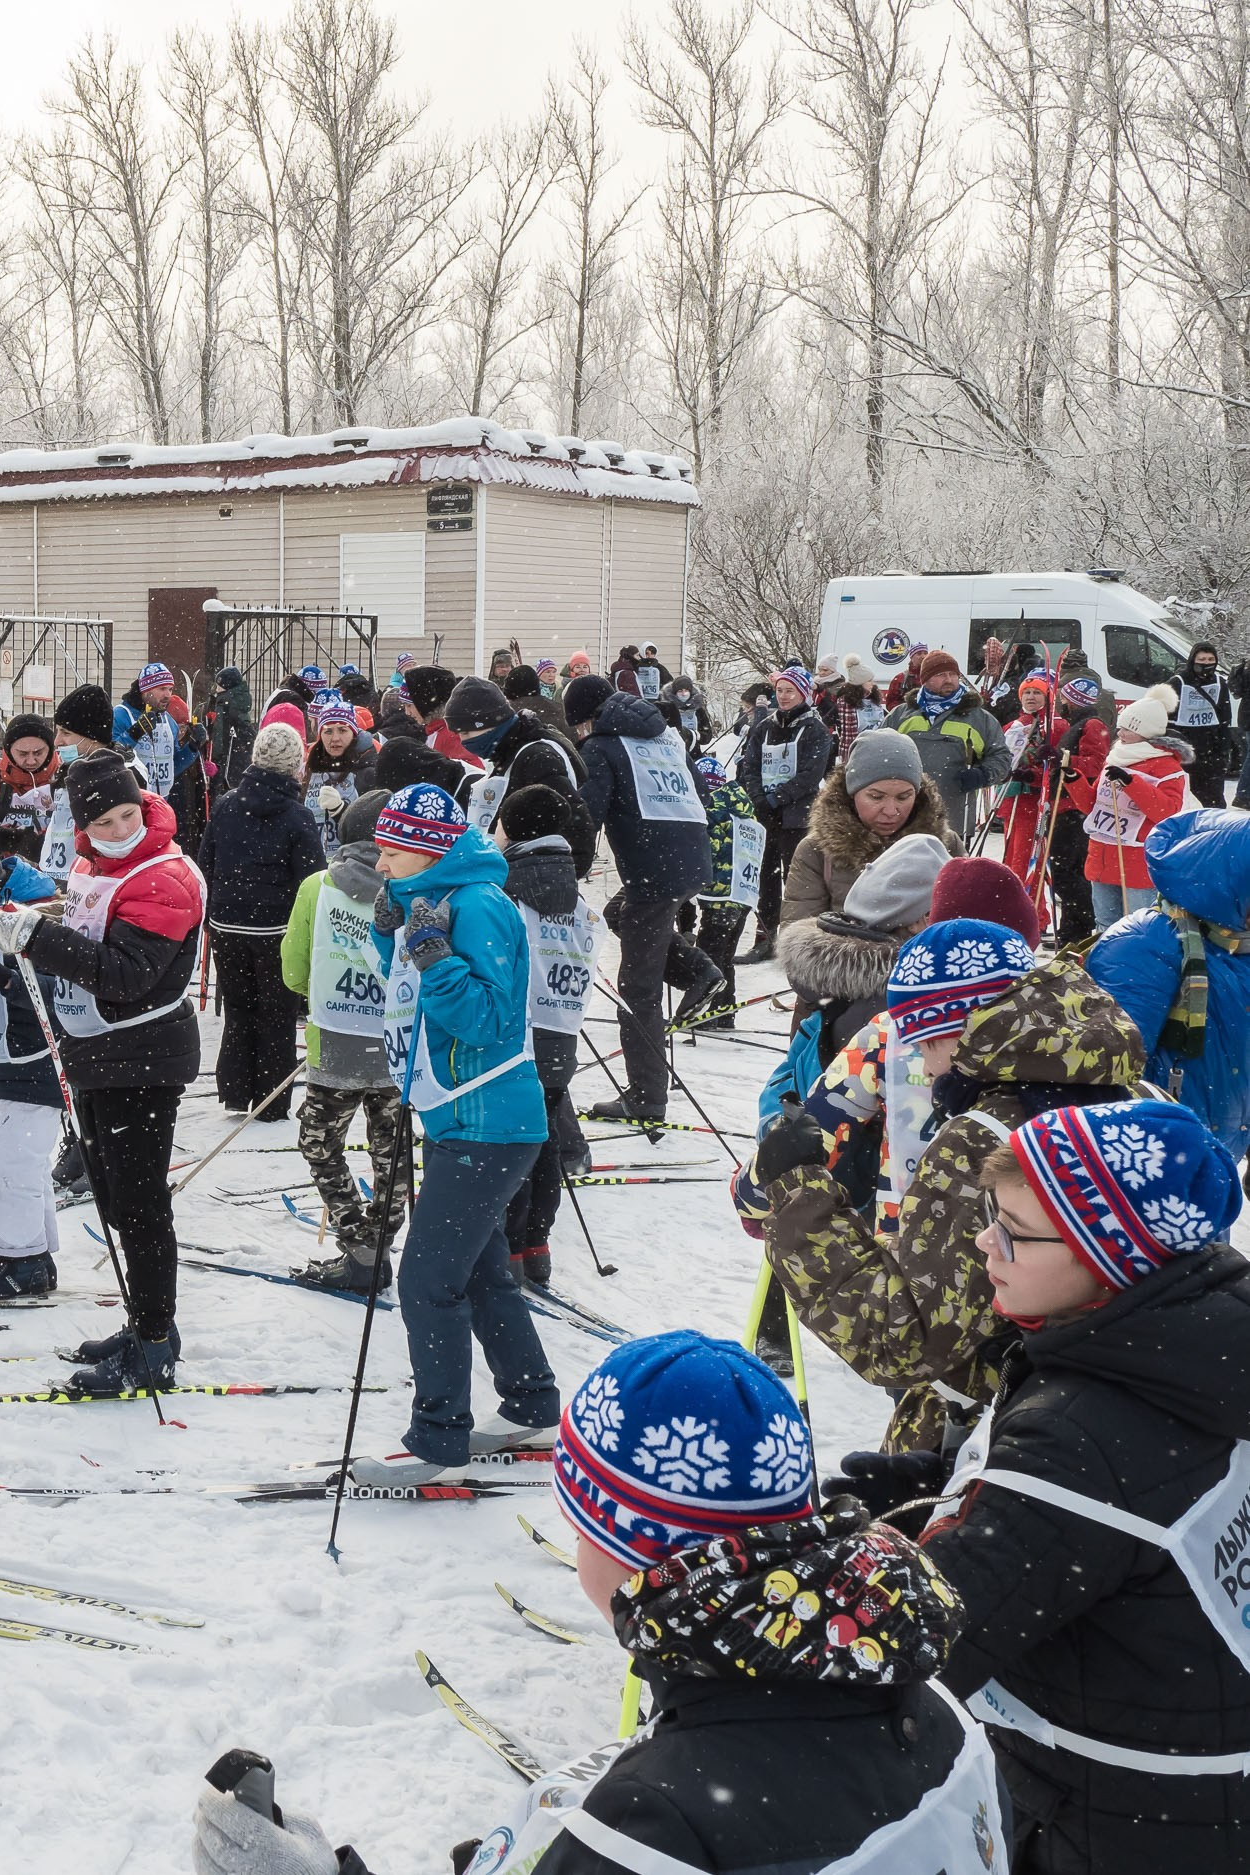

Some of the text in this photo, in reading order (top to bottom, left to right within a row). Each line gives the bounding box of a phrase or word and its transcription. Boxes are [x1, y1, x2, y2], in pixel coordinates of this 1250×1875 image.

[1188, 712, 1214, 726] 4189
[329, 907, 371, 932] ЛЫЖНЯ
[334, 967, 386, 1005] 456
[905, 1073, 931, 1087] СПО
[1213, 1488, 1250, 1581] ЛЫЖ
